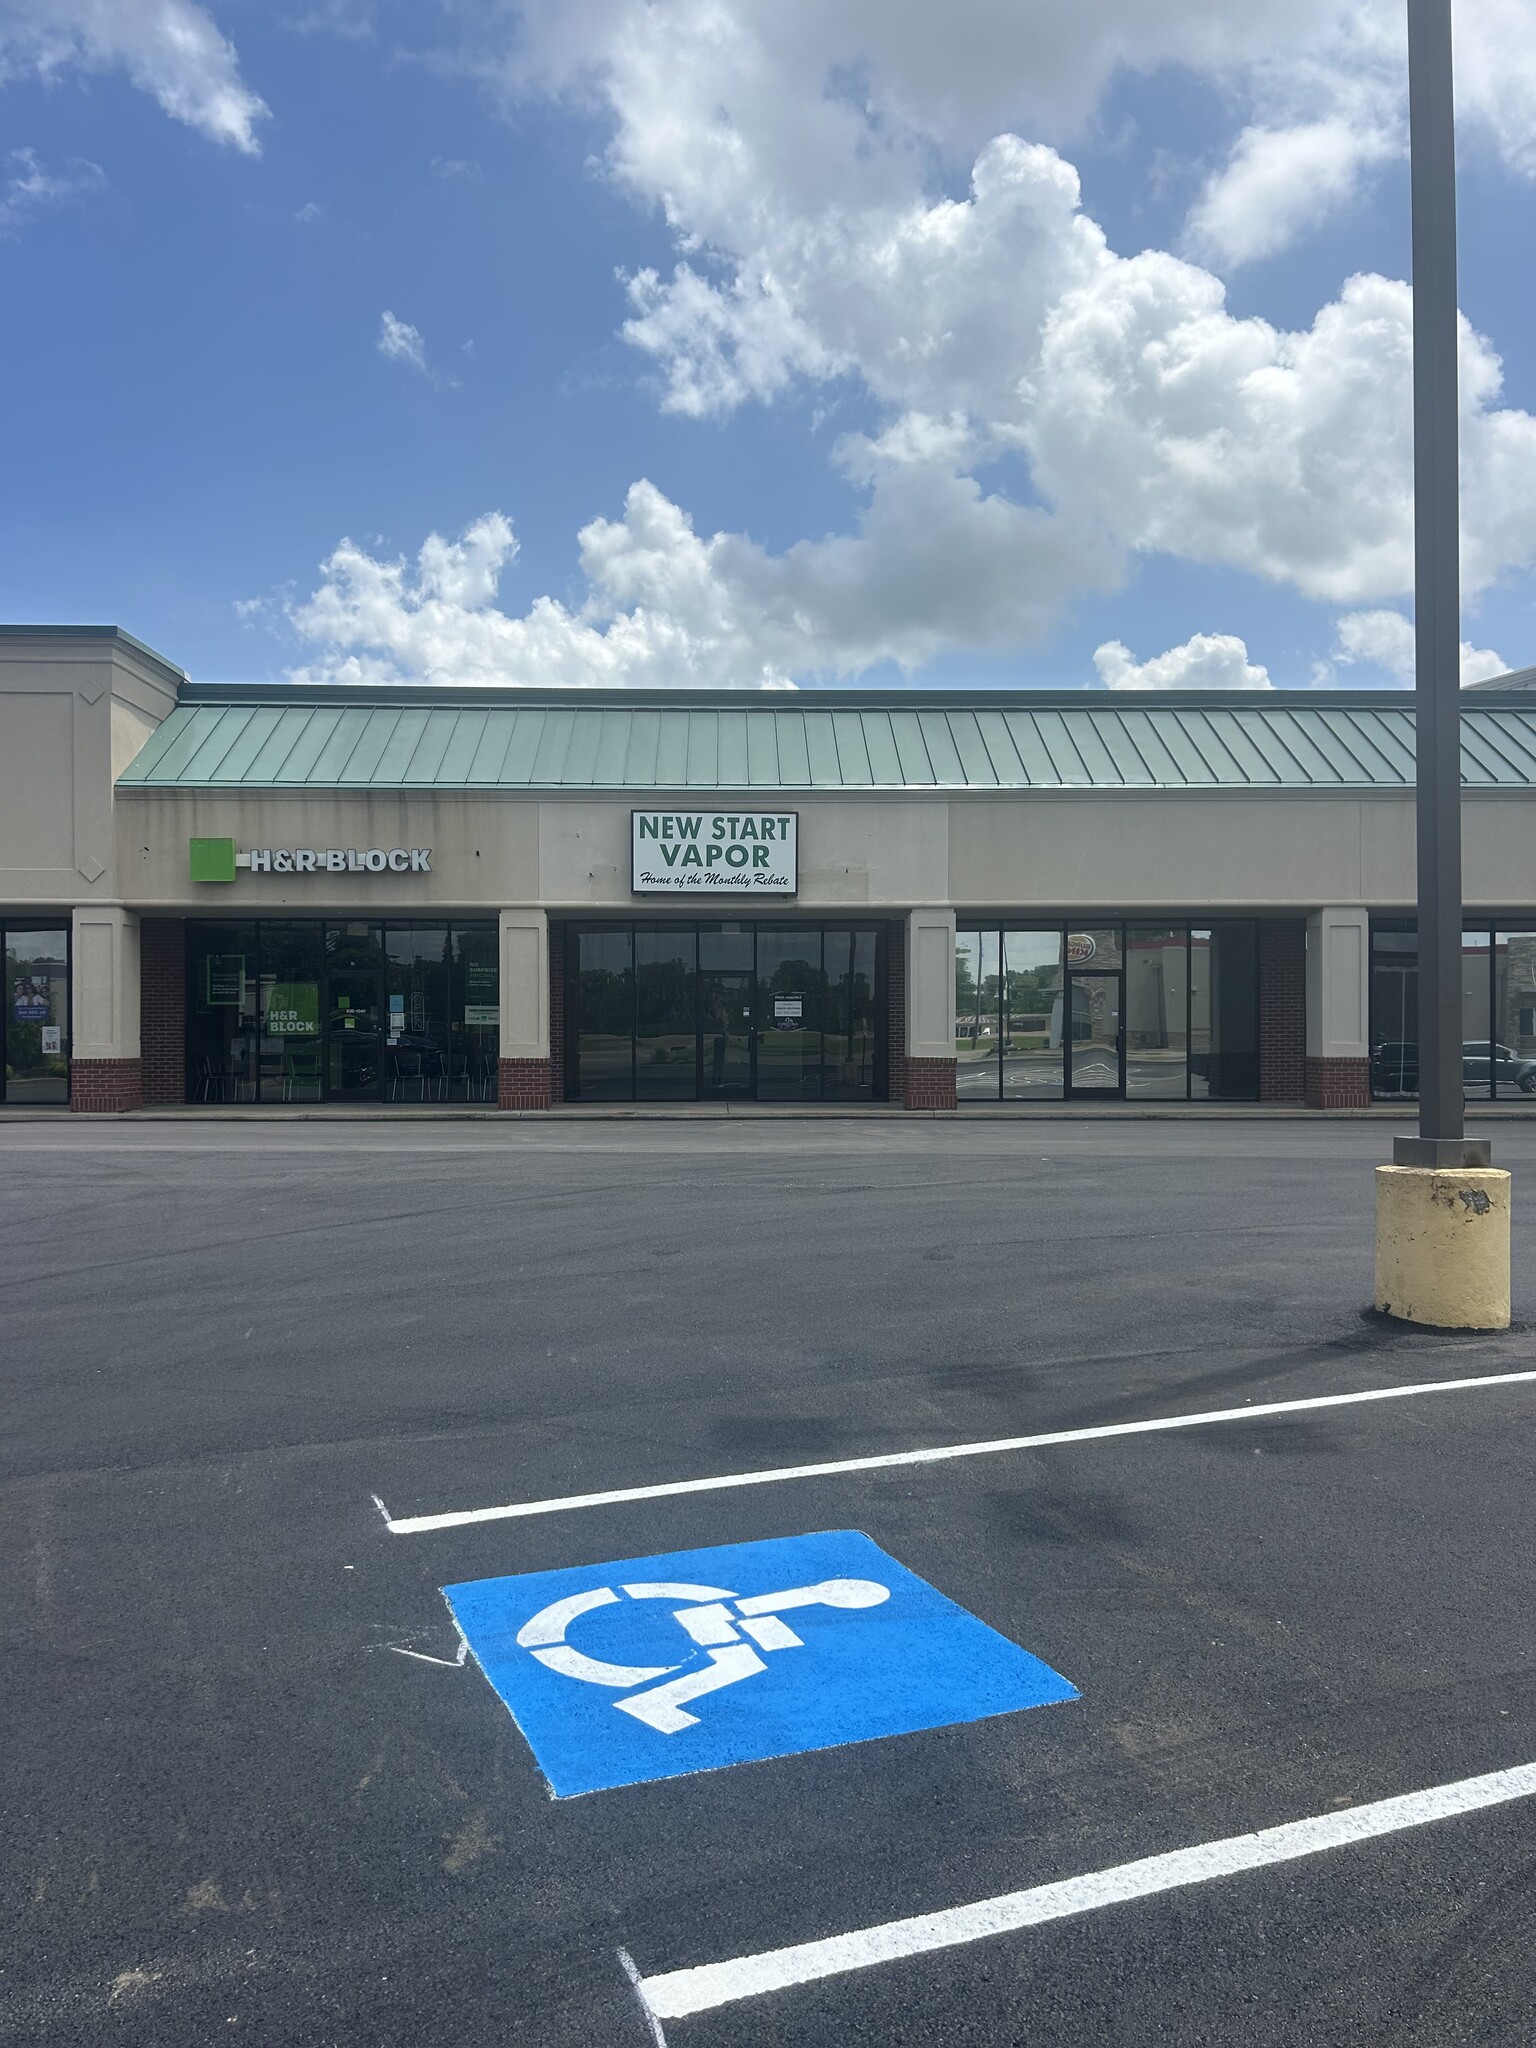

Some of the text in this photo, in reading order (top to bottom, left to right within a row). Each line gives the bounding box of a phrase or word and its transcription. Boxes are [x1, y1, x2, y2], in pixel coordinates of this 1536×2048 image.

[639, 815, 791, 841] NEW START
[250, 848, 432, 872] H&R BLOCK
[659, 844, 770, 868] VAPOR
[639, 871, 790, 888] Home of the Monthly Rebate
[270, 1010, 298, 1021] H&R
[270, 1021, 314, 1032] BLOCK
